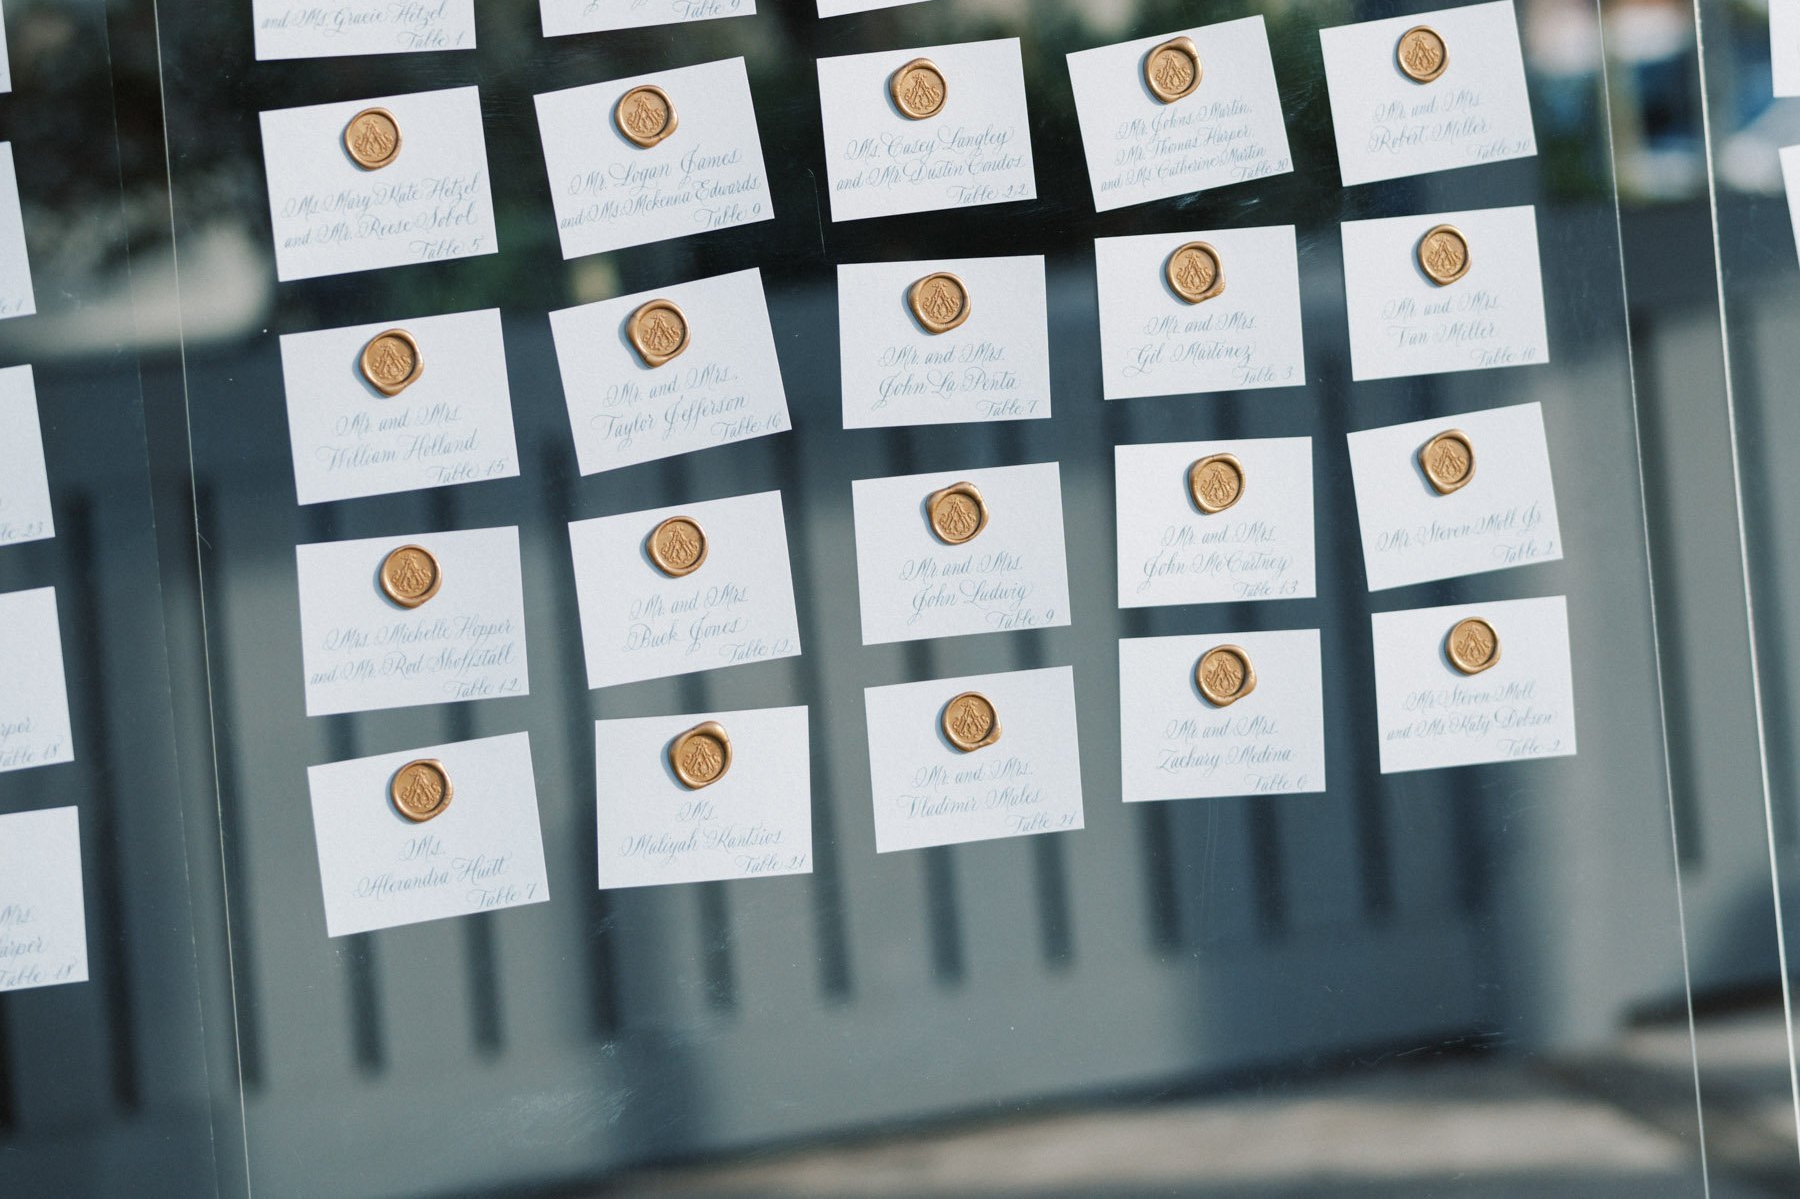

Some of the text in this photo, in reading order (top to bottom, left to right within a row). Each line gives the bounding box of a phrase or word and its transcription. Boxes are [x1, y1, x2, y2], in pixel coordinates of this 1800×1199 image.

[261, 10, 291, 29] and
[397, 29, 450, 48] Table
[1411, 95, 1438, 118] and
[836, 172, 865, 191] and
[1101, 174, 1123, 192] and
[946, 185, 1000, 204] Table
[561, 210, 587, 230] and
[694, 206, 750, 229] Table
[284, 228, 313, 248] and
[409, 239, 465, 260] Table
[1424, 296, 1452, 316] and
[1185, 314, 1214, 332] and
[925, 344, 956, 364] and
[1232, 364, 1277, 385] Table
[650, 375, 680, 399] and
[976, 400, 1025, 418] Table
[379, 407, 410, 432] and
[711, 415, 762, 441] Table
[425, 461, 481, 483] Table
[1202, 524, 1230, 544] and
[943, 554, 974, 576] and
[1233, 581, 1272, 597] Table
[671, 591, 701, 614] and
[986, 609, 1041, 630] Table
[719, 639, 770, 663] Table
[311, 665, 339, 685] and
[443, 679, 496, 698] Table
[1203, 718, 1232, 738] and
[1386, 723, 1414, 740] and
[955, 762, 986, 784] and
[1244, 773, 1288, 791] Table
[1006, 812, 1049, 833] Table
[735, 854, 781, 873] Table
[467, 885, 522, 908] Table
